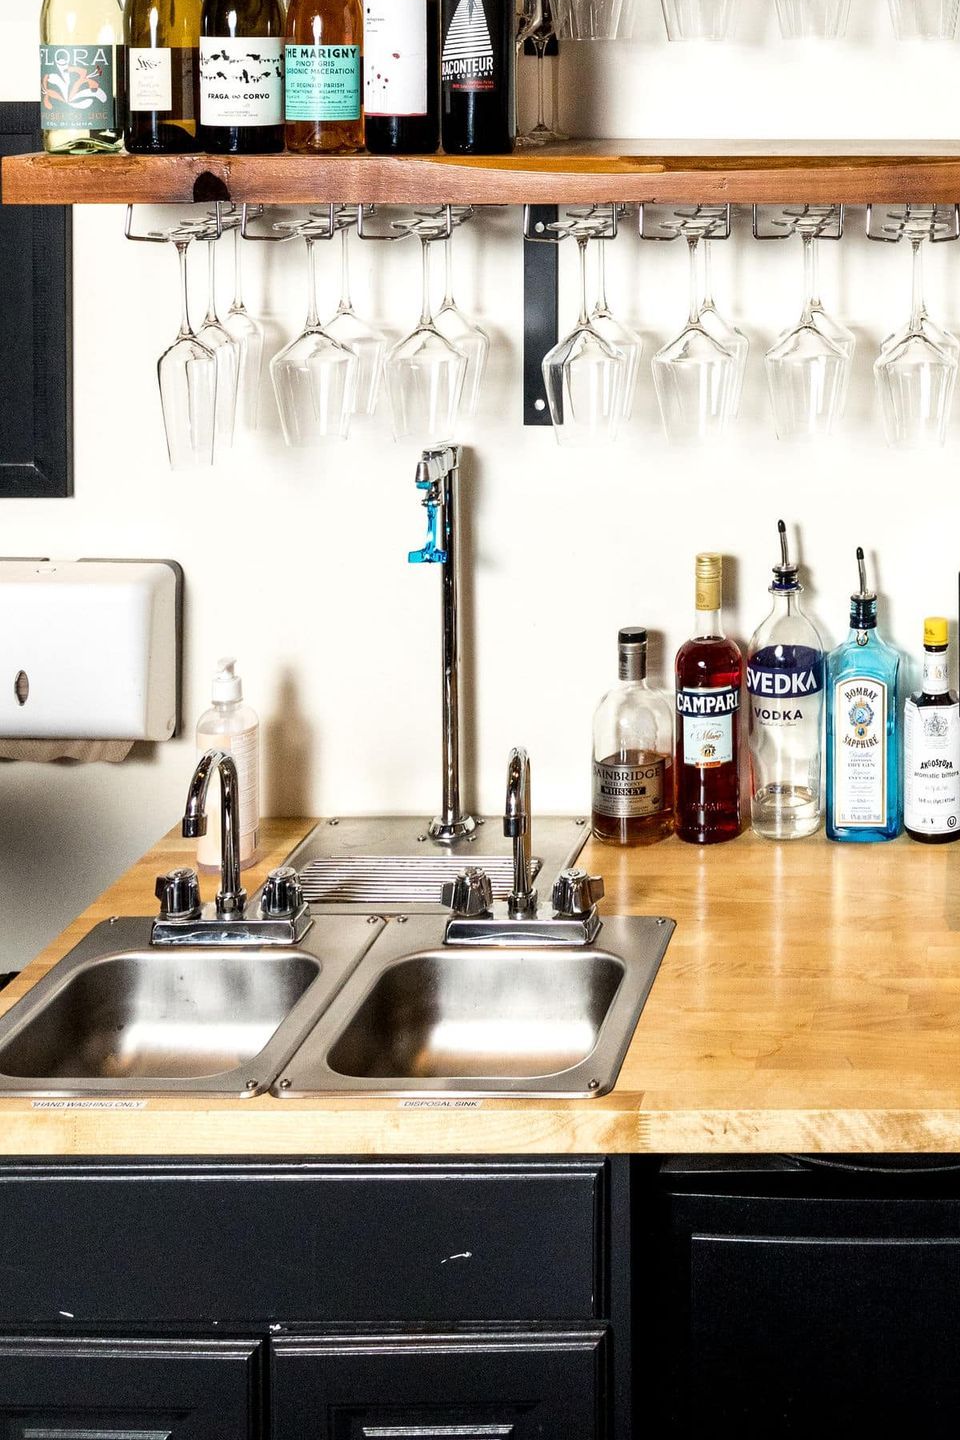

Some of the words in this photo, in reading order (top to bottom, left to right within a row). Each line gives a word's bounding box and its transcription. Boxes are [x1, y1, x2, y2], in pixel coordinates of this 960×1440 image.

[301, 48, 357, 58] MARIGNY
[442, 56, 494, 76] RACONTEUR
[457, 71, 493, 79] COMPANY
[746, 666, 818, 694] SVEDKA
[844, 687, 879, 700] BOMBAY
[677, 691, 739, 714] CAMPARI
[754, 707, 803, 720] VODKA
[843, 733, 879, 749] SAPPHIRE
[920, 759, 954, 770] ANGOSTURA
[914, 771, 940, 779] aromatic
[603, 788, 642, 796] WHISKEY
